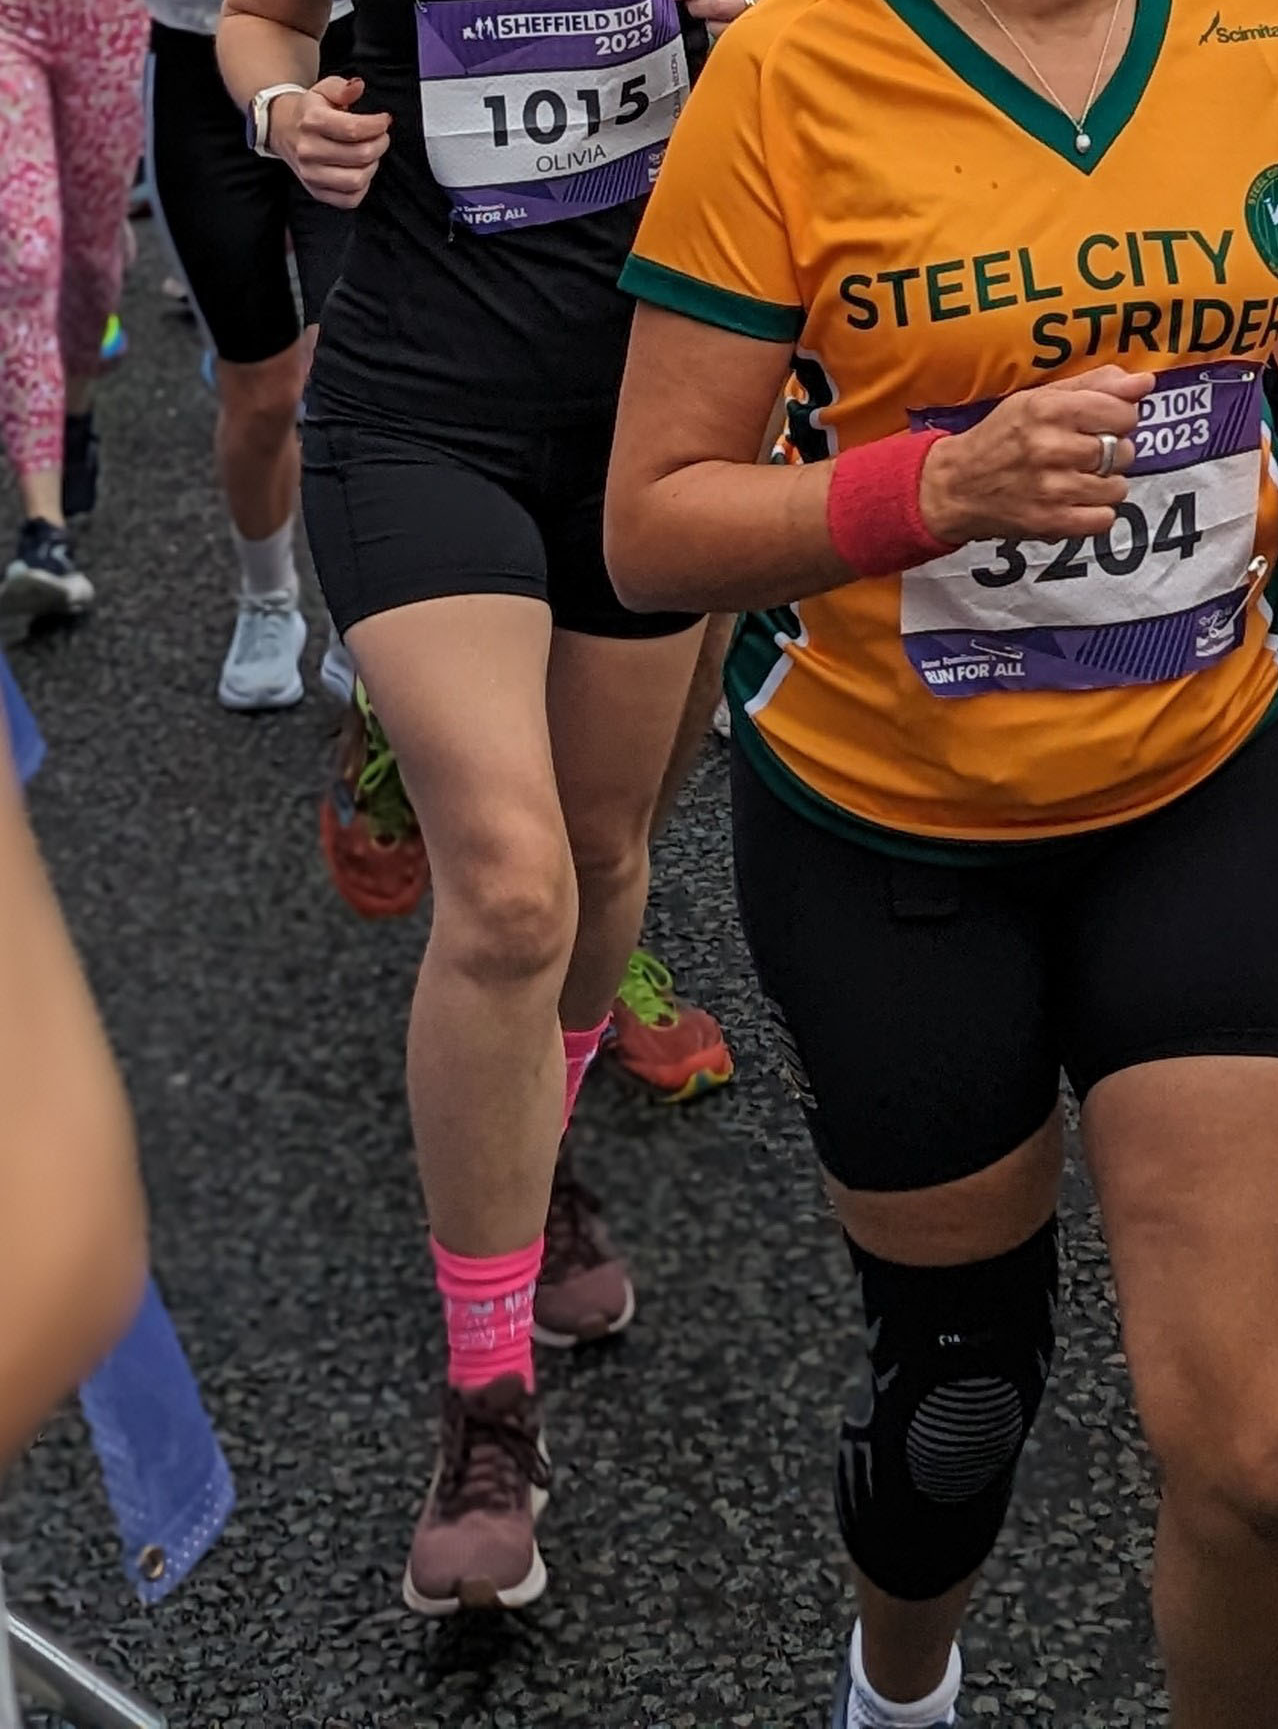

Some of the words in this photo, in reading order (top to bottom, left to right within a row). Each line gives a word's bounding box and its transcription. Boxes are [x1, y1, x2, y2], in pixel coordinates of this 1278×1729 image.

[501, 13, 611, 36] SHEFFIELD
[614, 3, 650, 28] 10K
[595, 23, 654, 56] 2023
[483, 74, 650, 147] 1015
[535, 144, 607, 172] OLIVIA
[475, 211, 502, 225] FOR
[504, 207, 529, 221] ALL
[839, 247, 1063, 331] STEEL
[1077, 229, 1235, 291] CITY
[1161, 386, 1210, 418] 10K
[1135, 418, 1210, 458] 2023
[971, 492, 1204, 589] 3204
[923, 668, 955, 685] RUN
[956, 663, 991, 682] FOR
[992, 662, 1026, 677] ALL
